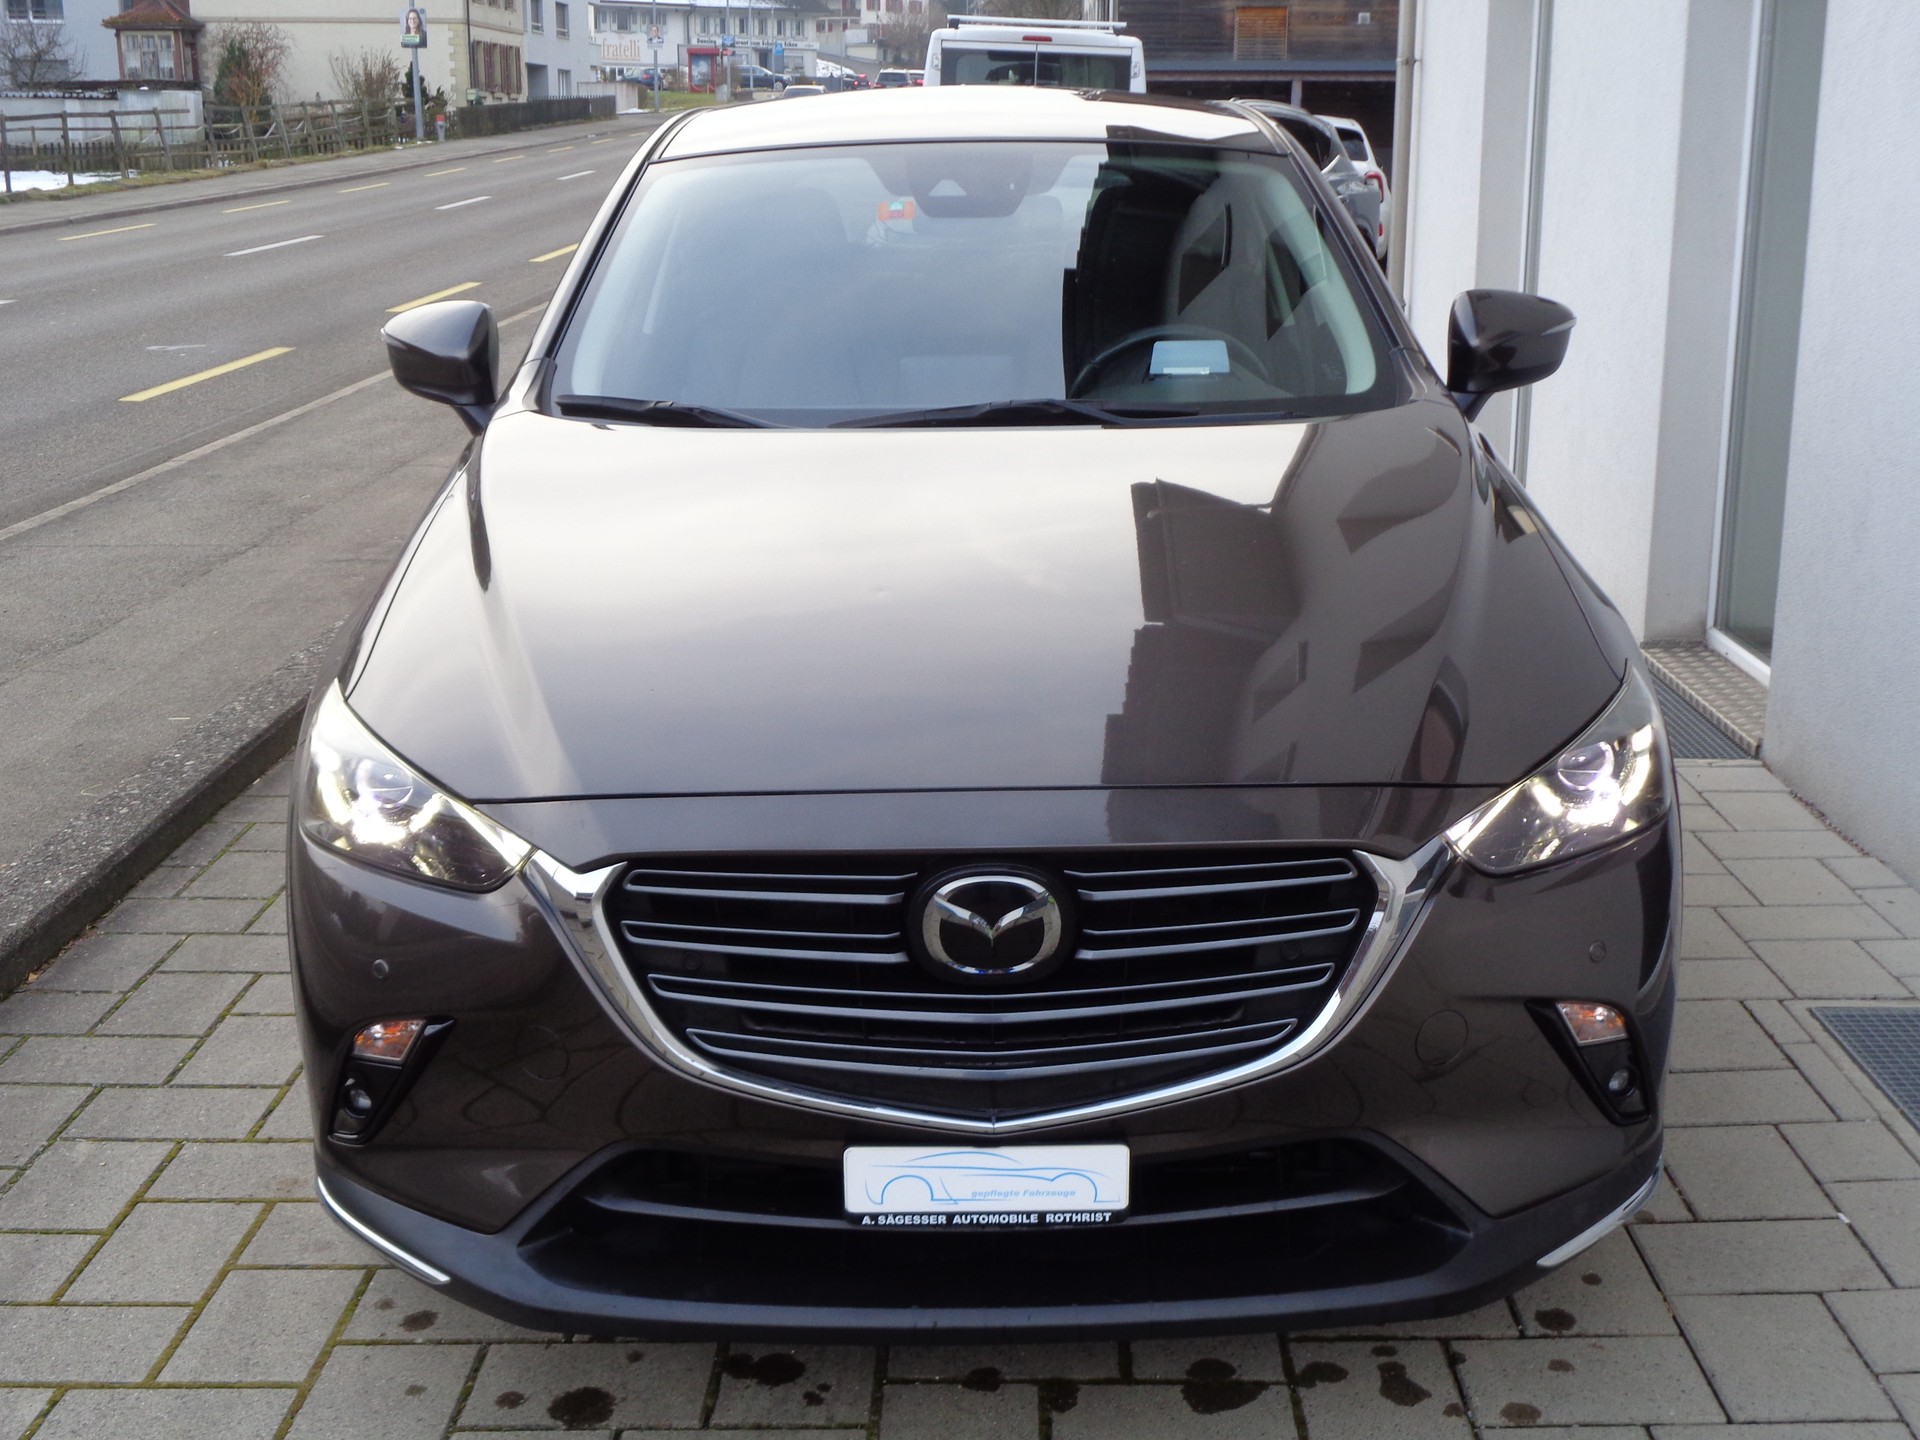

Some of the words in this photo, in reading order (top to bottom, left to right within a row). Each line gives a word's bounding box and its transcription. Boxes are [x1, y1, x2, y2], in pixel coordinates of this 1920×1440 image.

[602, 38, 640, 58] fratelli
[971, 1190, 1020, 1199] gepflegte
[1023, 1189, 1076, 1198] Fahrzeuge
[862, 1214, 875, 1226] A.
[878, 1212, 947, 1226] SÄGESSER
[953, 1213, 1039, 1225] AUTOMOBILE
[1045, 1212, 1112, 1224] ROTHRIST
